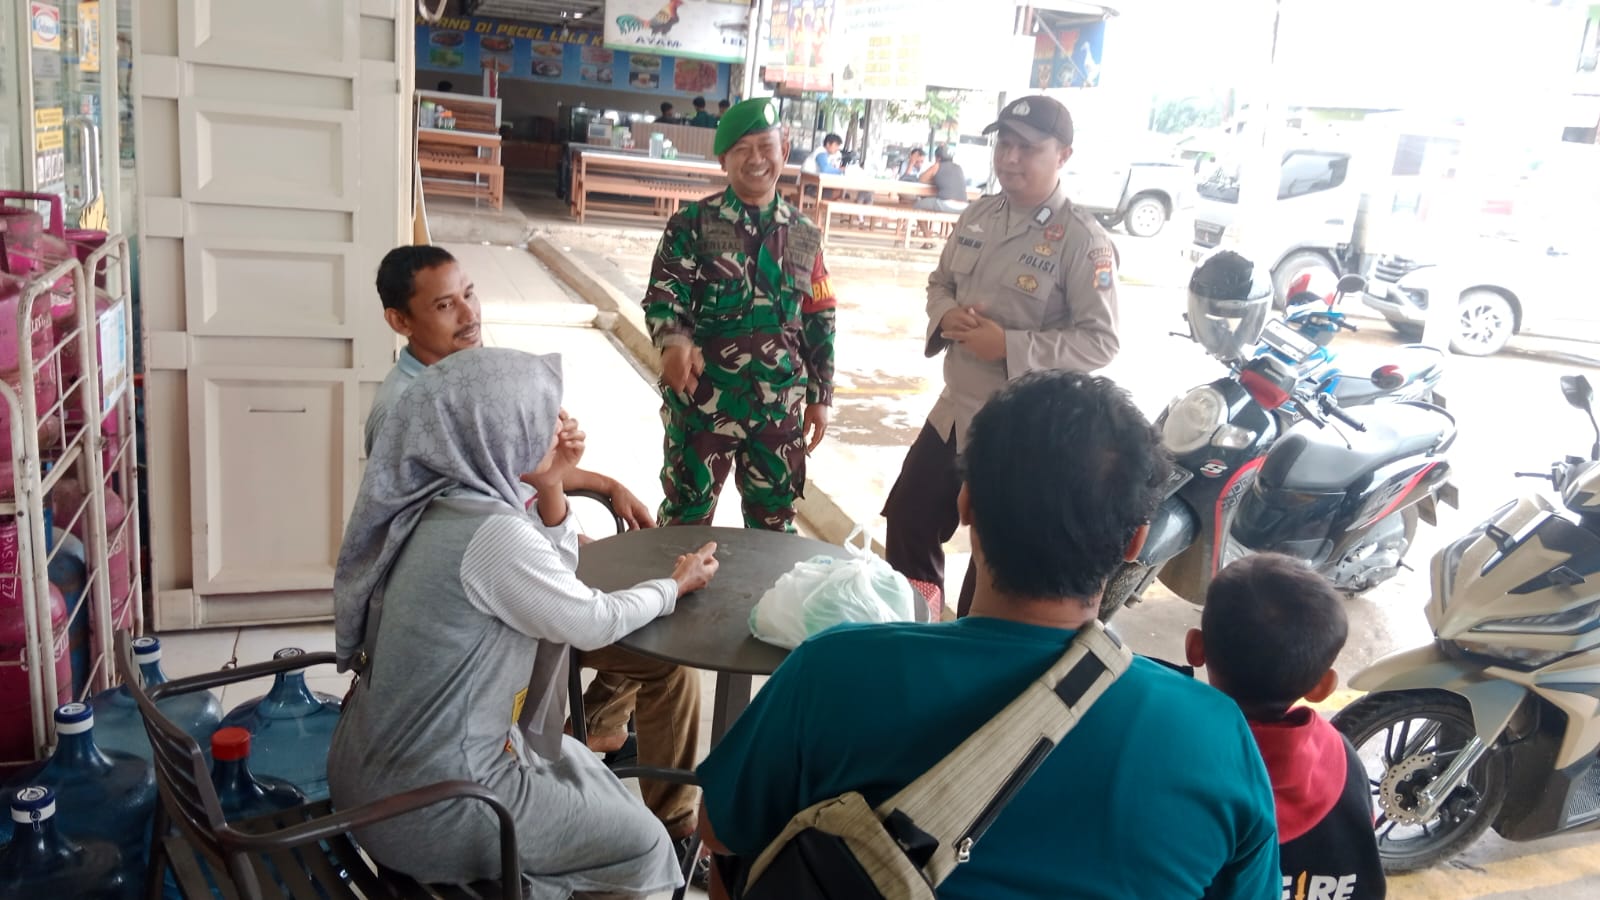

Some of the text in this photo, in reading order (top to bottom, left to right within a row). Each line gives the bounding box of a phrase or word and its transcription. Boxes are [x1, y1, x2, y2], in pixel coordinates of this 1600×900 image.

[474, 22, 493, 33] DI
[496, 23, 545, 40] PECEL
[635, 36, 681, 49] AYAM
[1017, 253, 1056, 274] POLISI
